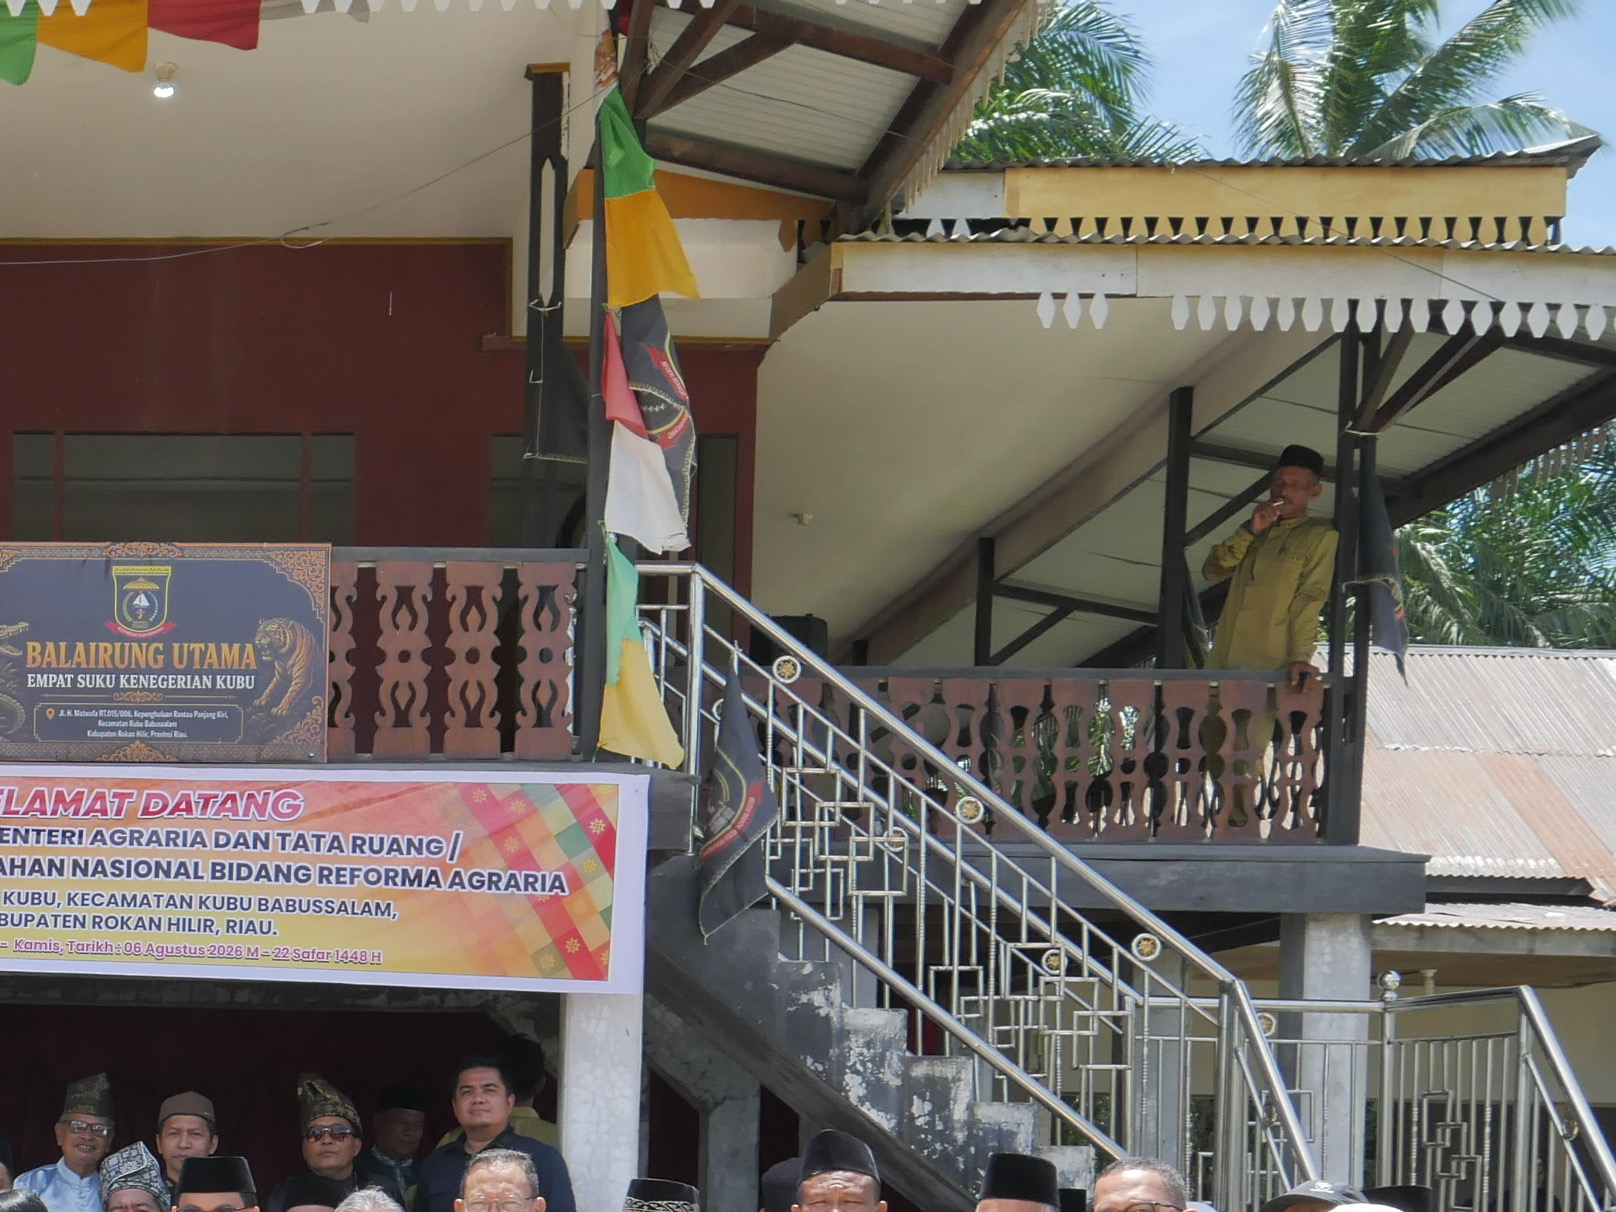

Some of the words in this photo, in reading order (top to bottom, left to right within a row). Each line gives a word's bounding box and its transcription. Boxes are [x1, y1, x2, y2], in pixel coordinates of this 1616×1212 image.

[26, 641, 164, 669] BALAIRUNG
[172, 642, 258, 670] UTAMA
[27, 673, 74, 688] EMPAT
[77, 674, 116, 688] SUKU
[119, 674, 212, 689] KENEGERIAN
[216, 675, 256, 690] KUBU
[66, 709, 73, 717] H.
[194, 710, 216, 719] Panjang
[98, 719, 128, 727] Kecamatan
[129, 719, 143, 727] Kubu
[87, 729, 117, 738] Kabupaten
[117, 730, 135, 738] Rokan
[150, 730, 173, 738] Provinsi
[141, 790, 302, 819] DATANG
[89, 829, 206, 848] AGRARIA
[214, 831, 270, 850] DAN
[276, 832, 345, 853] TATA
[351, 835, 444, 856] RUANG
[71, 858, 204, 880] NASIONAL
[211, 862, 312, 883] BIDANG
[318, 865, 442, 888] REFORMA
[448, 869, 567, 893] AGRARIA
[4, 891, 62, 908] KUBU,
[67, 893, 193, 910] KECAMATAN
[199, 895, 252, 911] KUBU
[258, 898, 398, 920] BABUSSALAM,
[92, 915, 162, 932] ROKAN
[168, 918, 220, 936] HILIR,
[226, 920, 277, 936] RIAU.
[14, 939, 64, 953] Kamis,
[68, 940, 113, 953] Tarikh
[124, 942, 141, 954] 06
[146, 943, 205, 959] Agustus
[209, 945, 242, 958] 2026
[247, 946, 259, 959] M
[273, 947, 289, 960] 22
[294, 947, 332, 961] Safar
[335, 949, 368, 962] 1448
[372, 951, 382, 963] H
